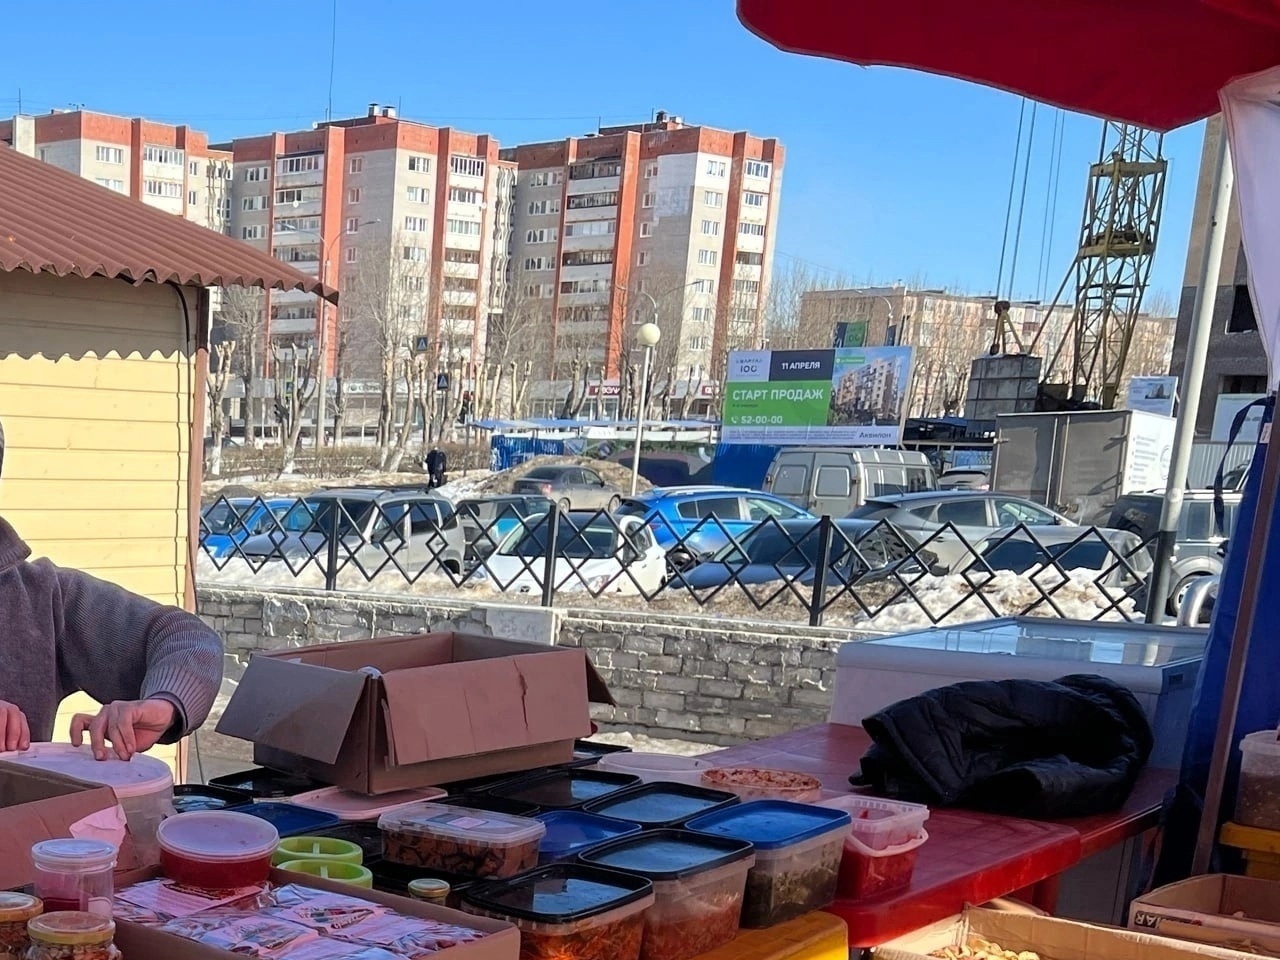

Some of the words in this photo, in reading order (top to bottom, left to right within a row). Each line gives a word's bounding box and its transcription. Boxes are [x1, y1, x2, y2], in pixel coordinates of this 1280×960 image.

[740, 365, 758, 373] 100
[781, 362, 789, 370] 11
[789, 361, 821, 370] АПРЕЛЯ
[732, 389, 768, 401] СТАРТ
[770, 388, 824, 402] ПРОДАЖ
[740, 415, 783, 424] 52-00-00
